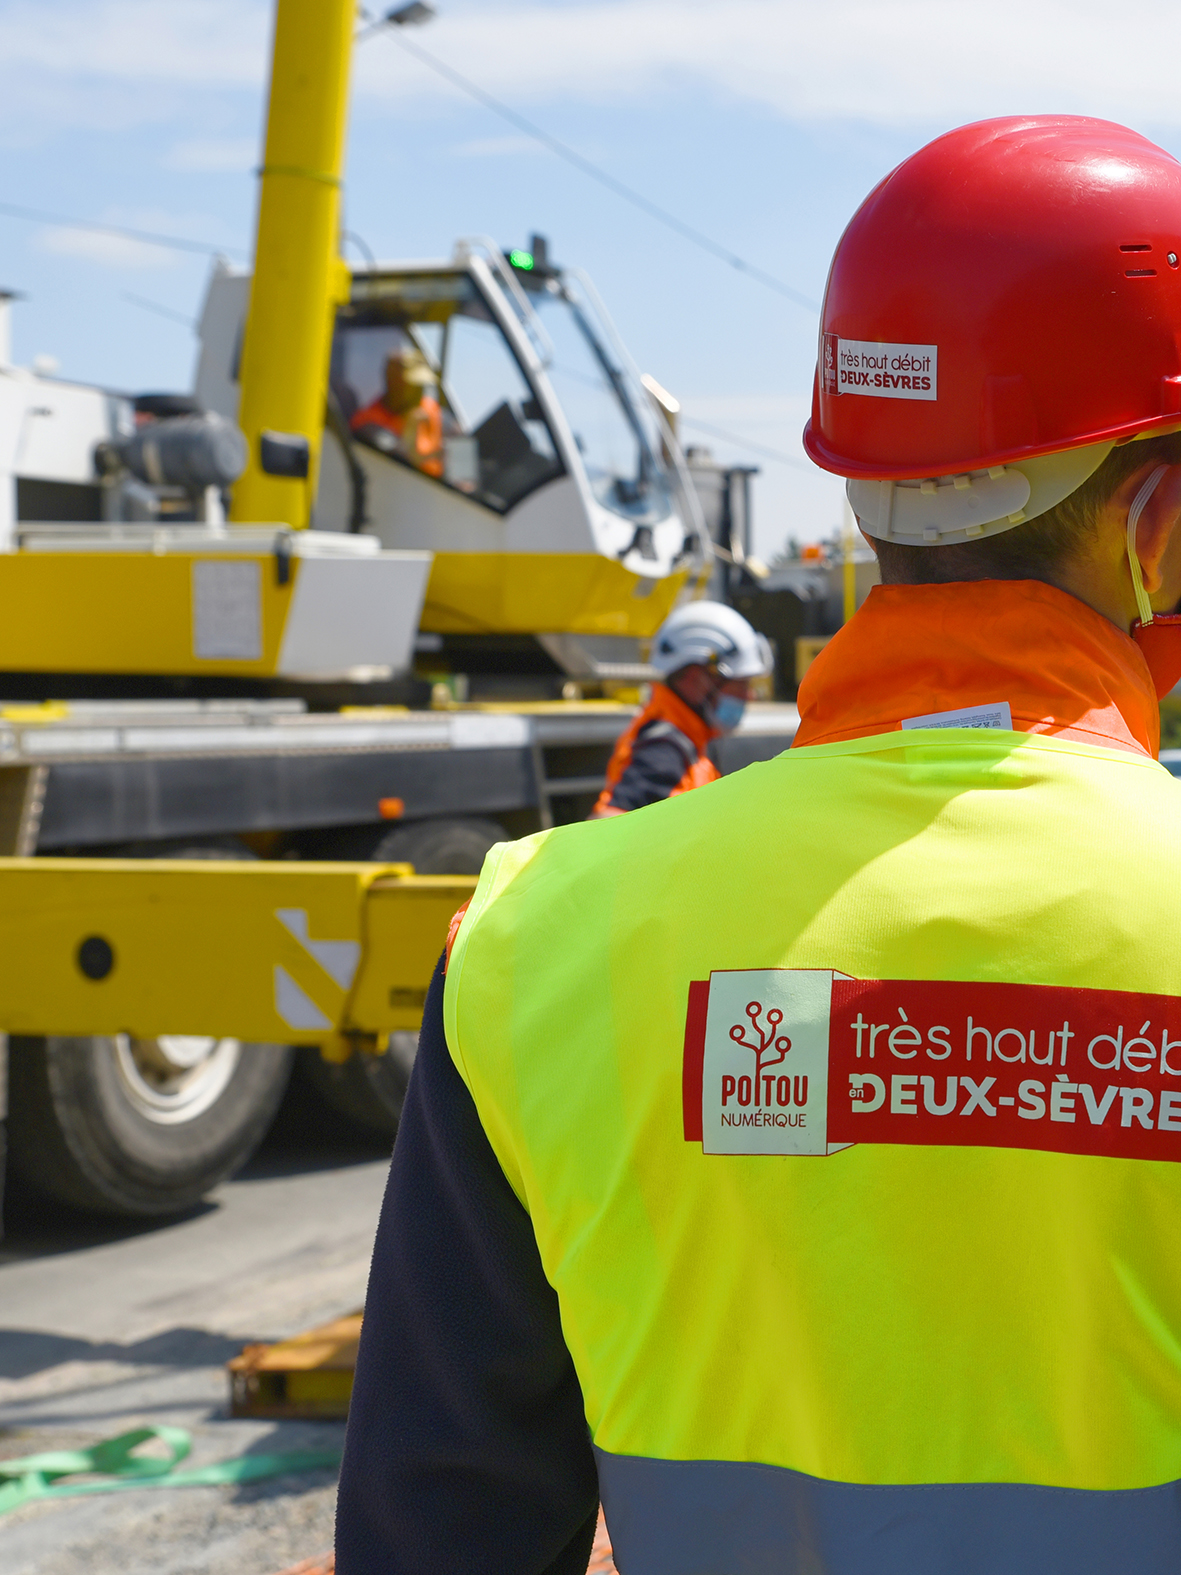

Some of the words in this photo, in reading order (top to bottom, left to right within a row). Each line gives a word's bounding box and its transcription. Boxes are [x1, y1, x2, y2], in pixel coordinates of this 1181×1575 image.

[840, 349, 860, 368] très
[861, 352, 888, 370] haut
[890, 353, 931, 372] débit
[840, 370, 931, 390] DEUX-SÈVRES
[850, 1006, 952, 1060] très
[966, 1016, 1074, 1067] haut
[721, 1074, 808, 1108] POITOU
[848, 1088, 864, 1098] en
[720, 1108, 808, 1129] NUMÉRIQUE
